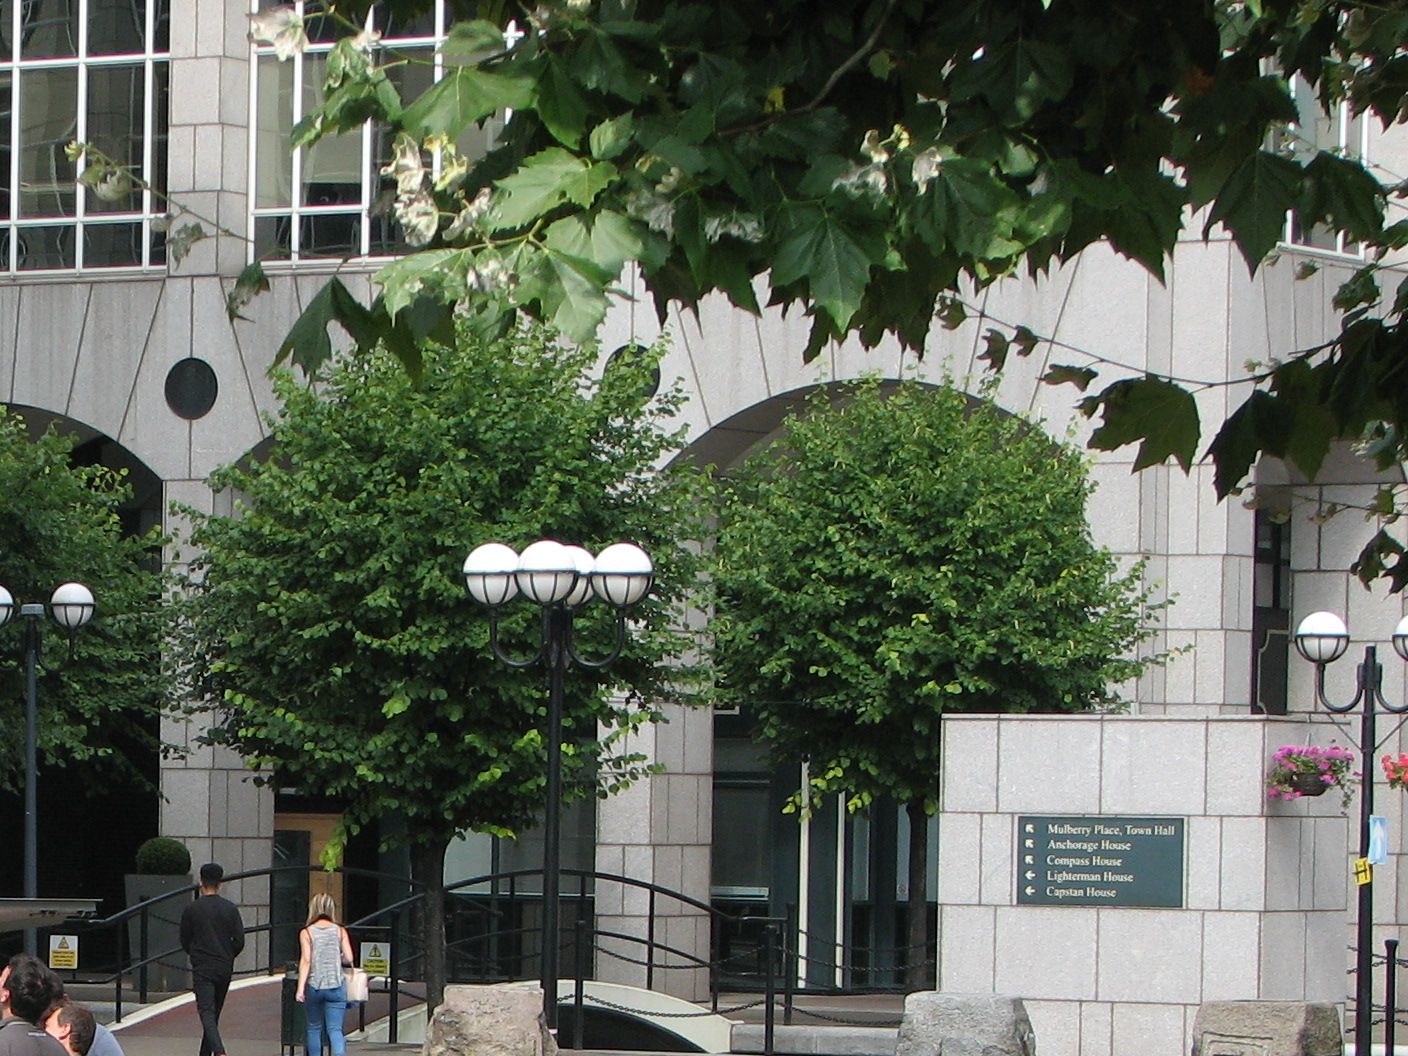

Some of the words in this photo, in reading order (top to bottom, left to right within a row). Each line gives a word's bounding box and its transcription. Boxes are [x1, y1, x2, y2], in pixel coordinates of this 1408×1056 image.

[1047, 824, 1092, 837] Mulberry
[1094, 825, 1123, 837] Place,
[1125, 825, 1152, 836] Town
[1154, 825, 1175, 836] Hall
[1047, 840, 1099, 852] Anchorage
[1101, 840, 1132, 851] House
[1046, 855, 1090, 868] Compass
[1092, 855, 1123, 867] House
[1046, 870, 1101, 883] Lighterman
[1103, 871, 1134, 882] House
[1046, 886, 1084, 899] Capstan
[1086, 887, 1117, 898] House
